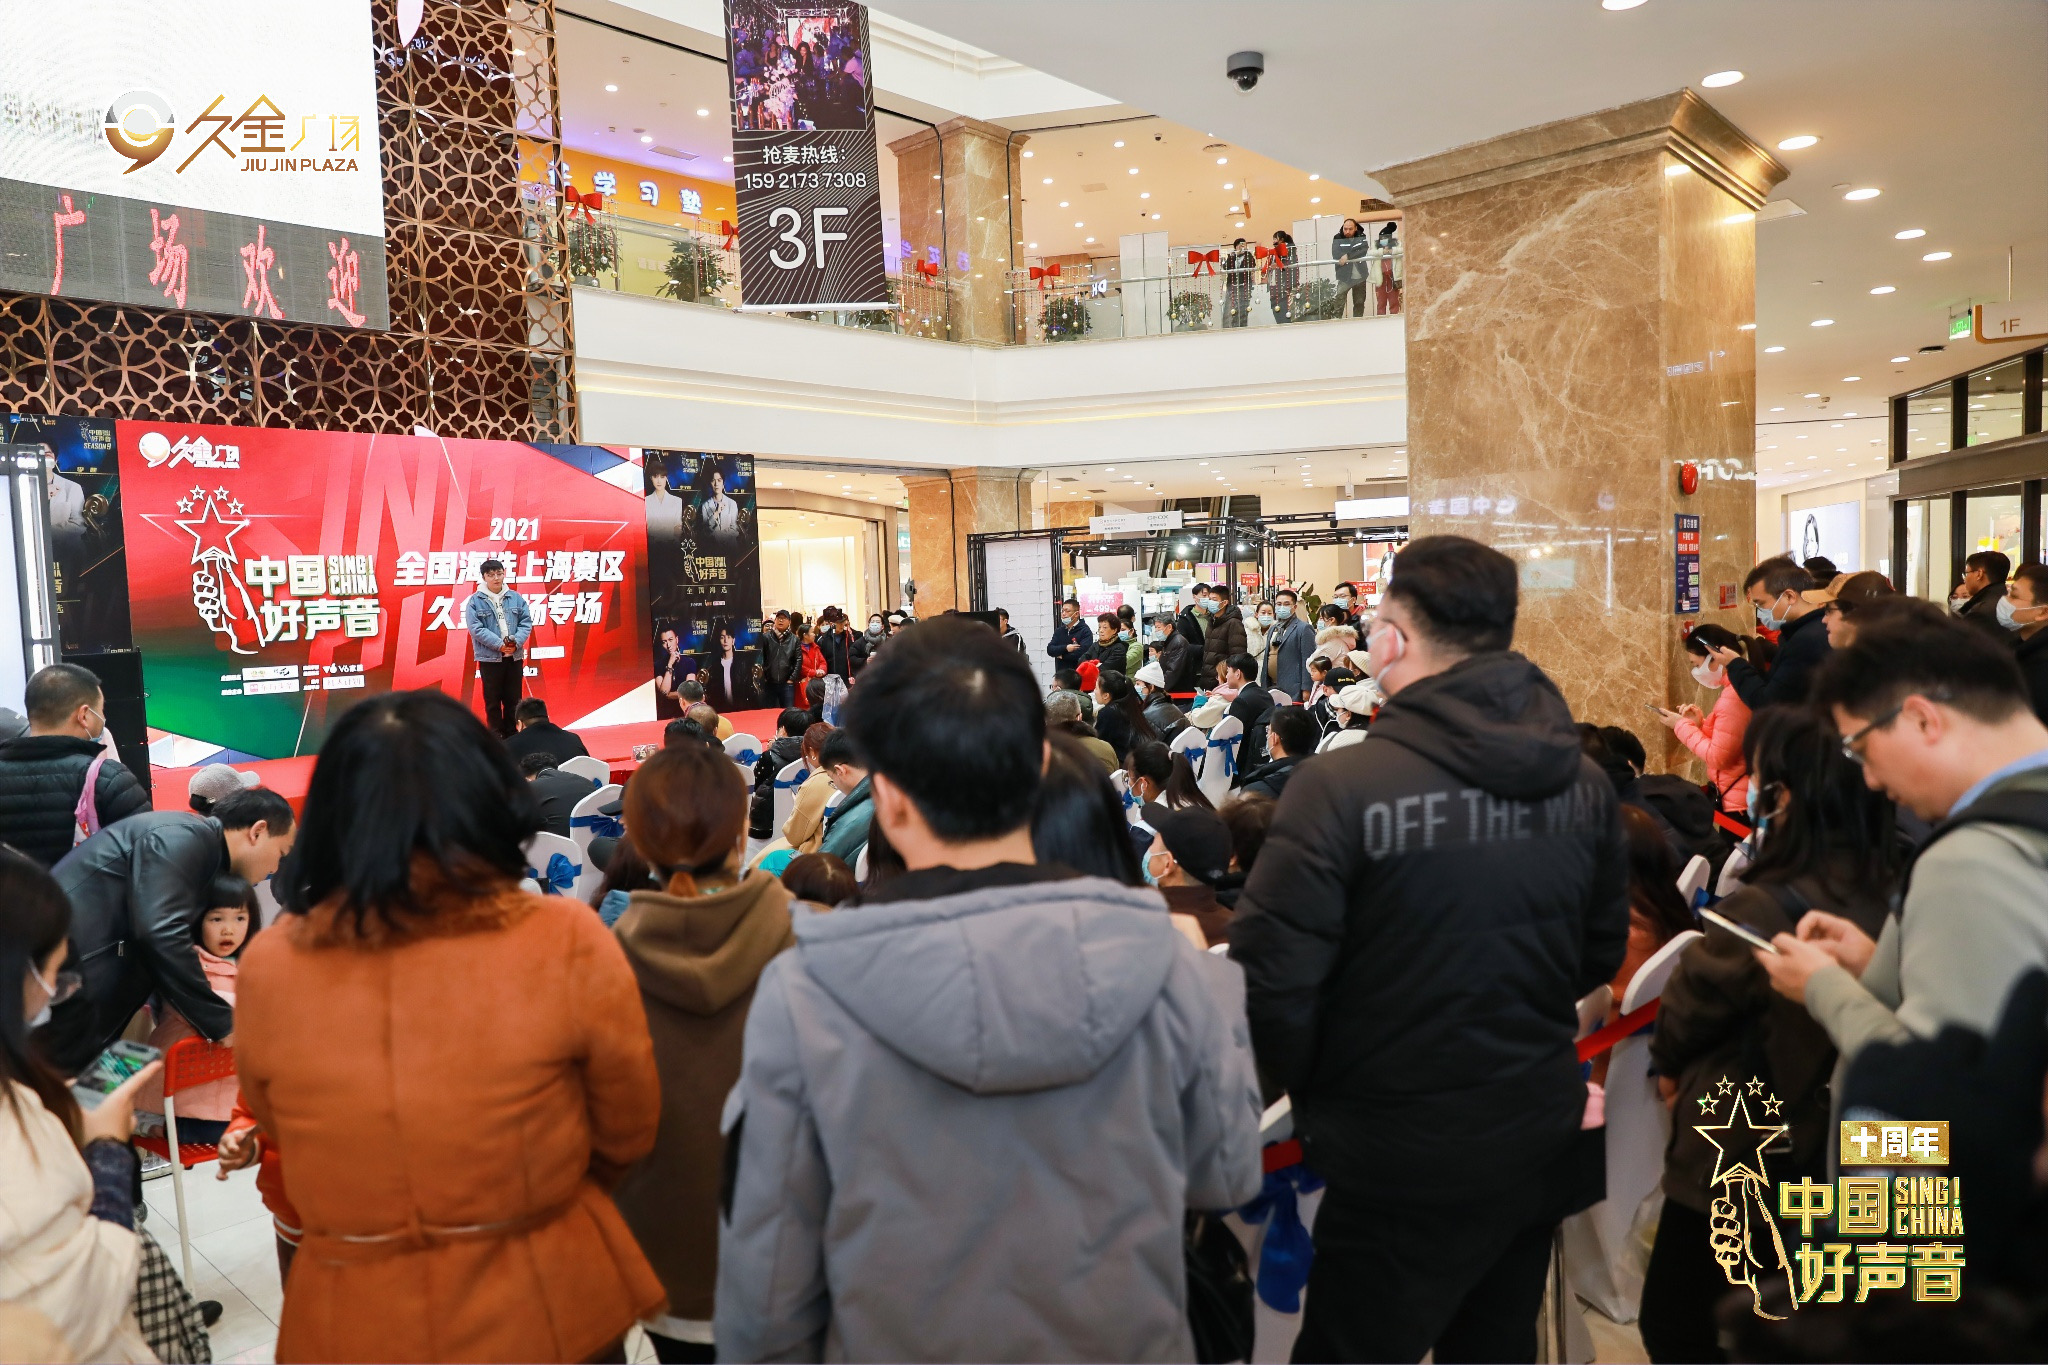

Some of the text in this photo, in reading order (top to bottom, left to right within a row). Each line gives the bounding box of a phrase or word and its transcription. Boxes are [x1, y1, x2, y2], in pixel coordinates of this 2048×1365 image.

[743, 172, 867, 190] 159 2173 7308
[768, 207, 849, 271] 3F
[50, 194, 366, 327] 广场欢迎
[2000, 318, 2021, 334] 1F
[489, 517, 539, 541] 2021
[245, 555, 328, 598] 中国
[330, 575, 379, 597] CHINA
[260, 597, 381, 642] 好声音
[426, 591, 604, 631] 久场专场
[1094, 604, 1110, 612] 499
[1363, 792, 1449, 861] OFF
[1460, 788, 1533, 845] THE
